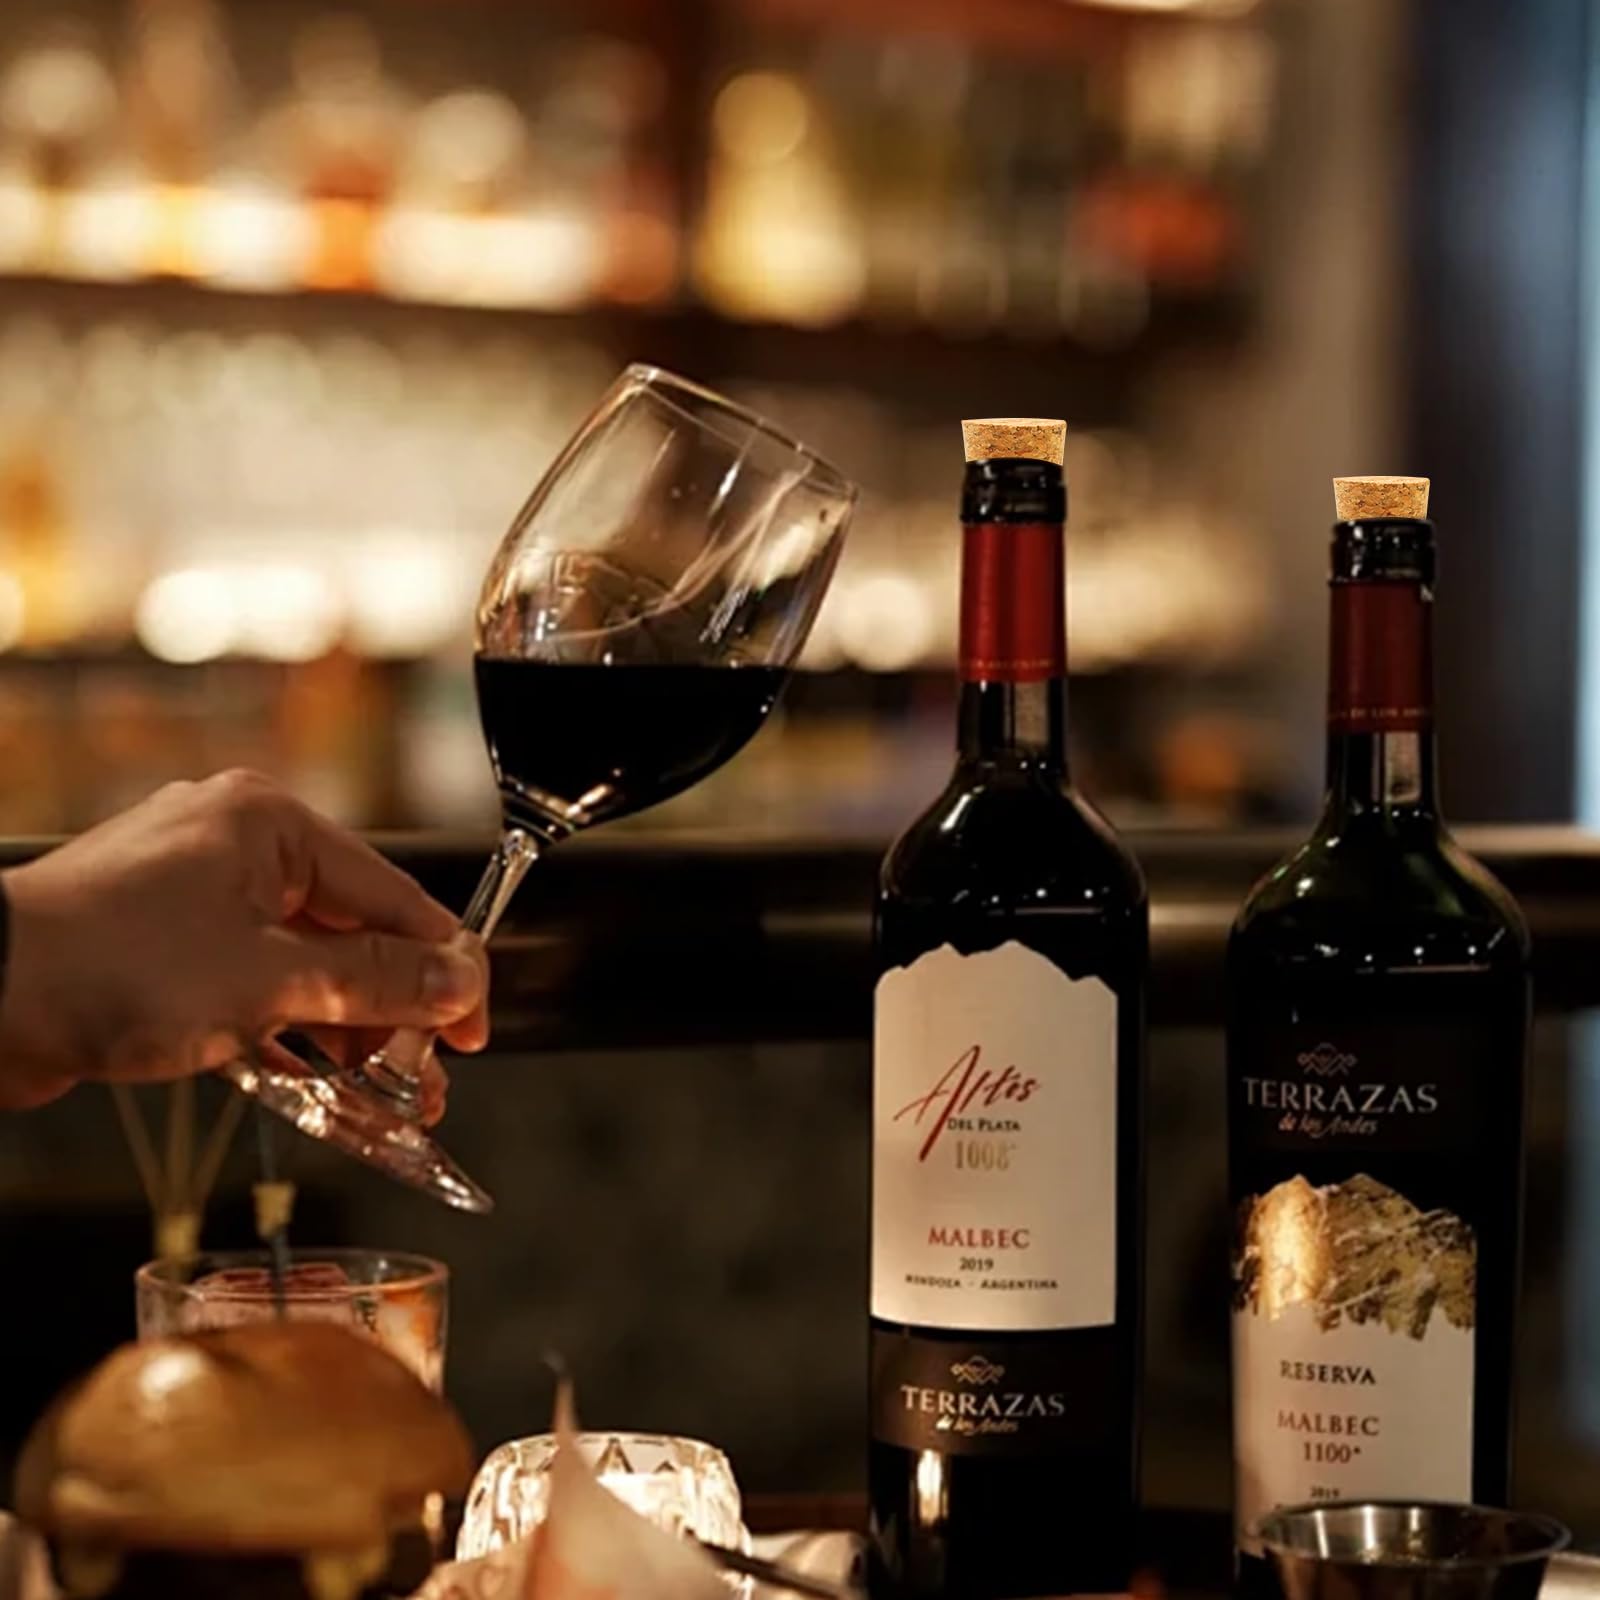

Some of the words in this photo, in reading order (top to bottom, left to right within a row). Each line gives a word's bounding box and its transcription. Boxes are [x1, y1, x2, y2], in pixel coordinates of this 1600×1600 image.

[1243, 1076, 1439, 1114] TERRAZAS
[947, 1117, 972, 1131] DEL
[978, 1118, 1021, 1133] PLATA
[928, 1226, 1031, 1250] MALBEC
[959, 1257, 994, 1271] 2019
[980, 1279, 1058, 1290] ARGENTINA
[1280, 1361, 1377, 1385] RESERVA
[901, 1384, 1066, 1417] TERRAZAS
[1277, 1409, 1380, 1437] MALBEC
